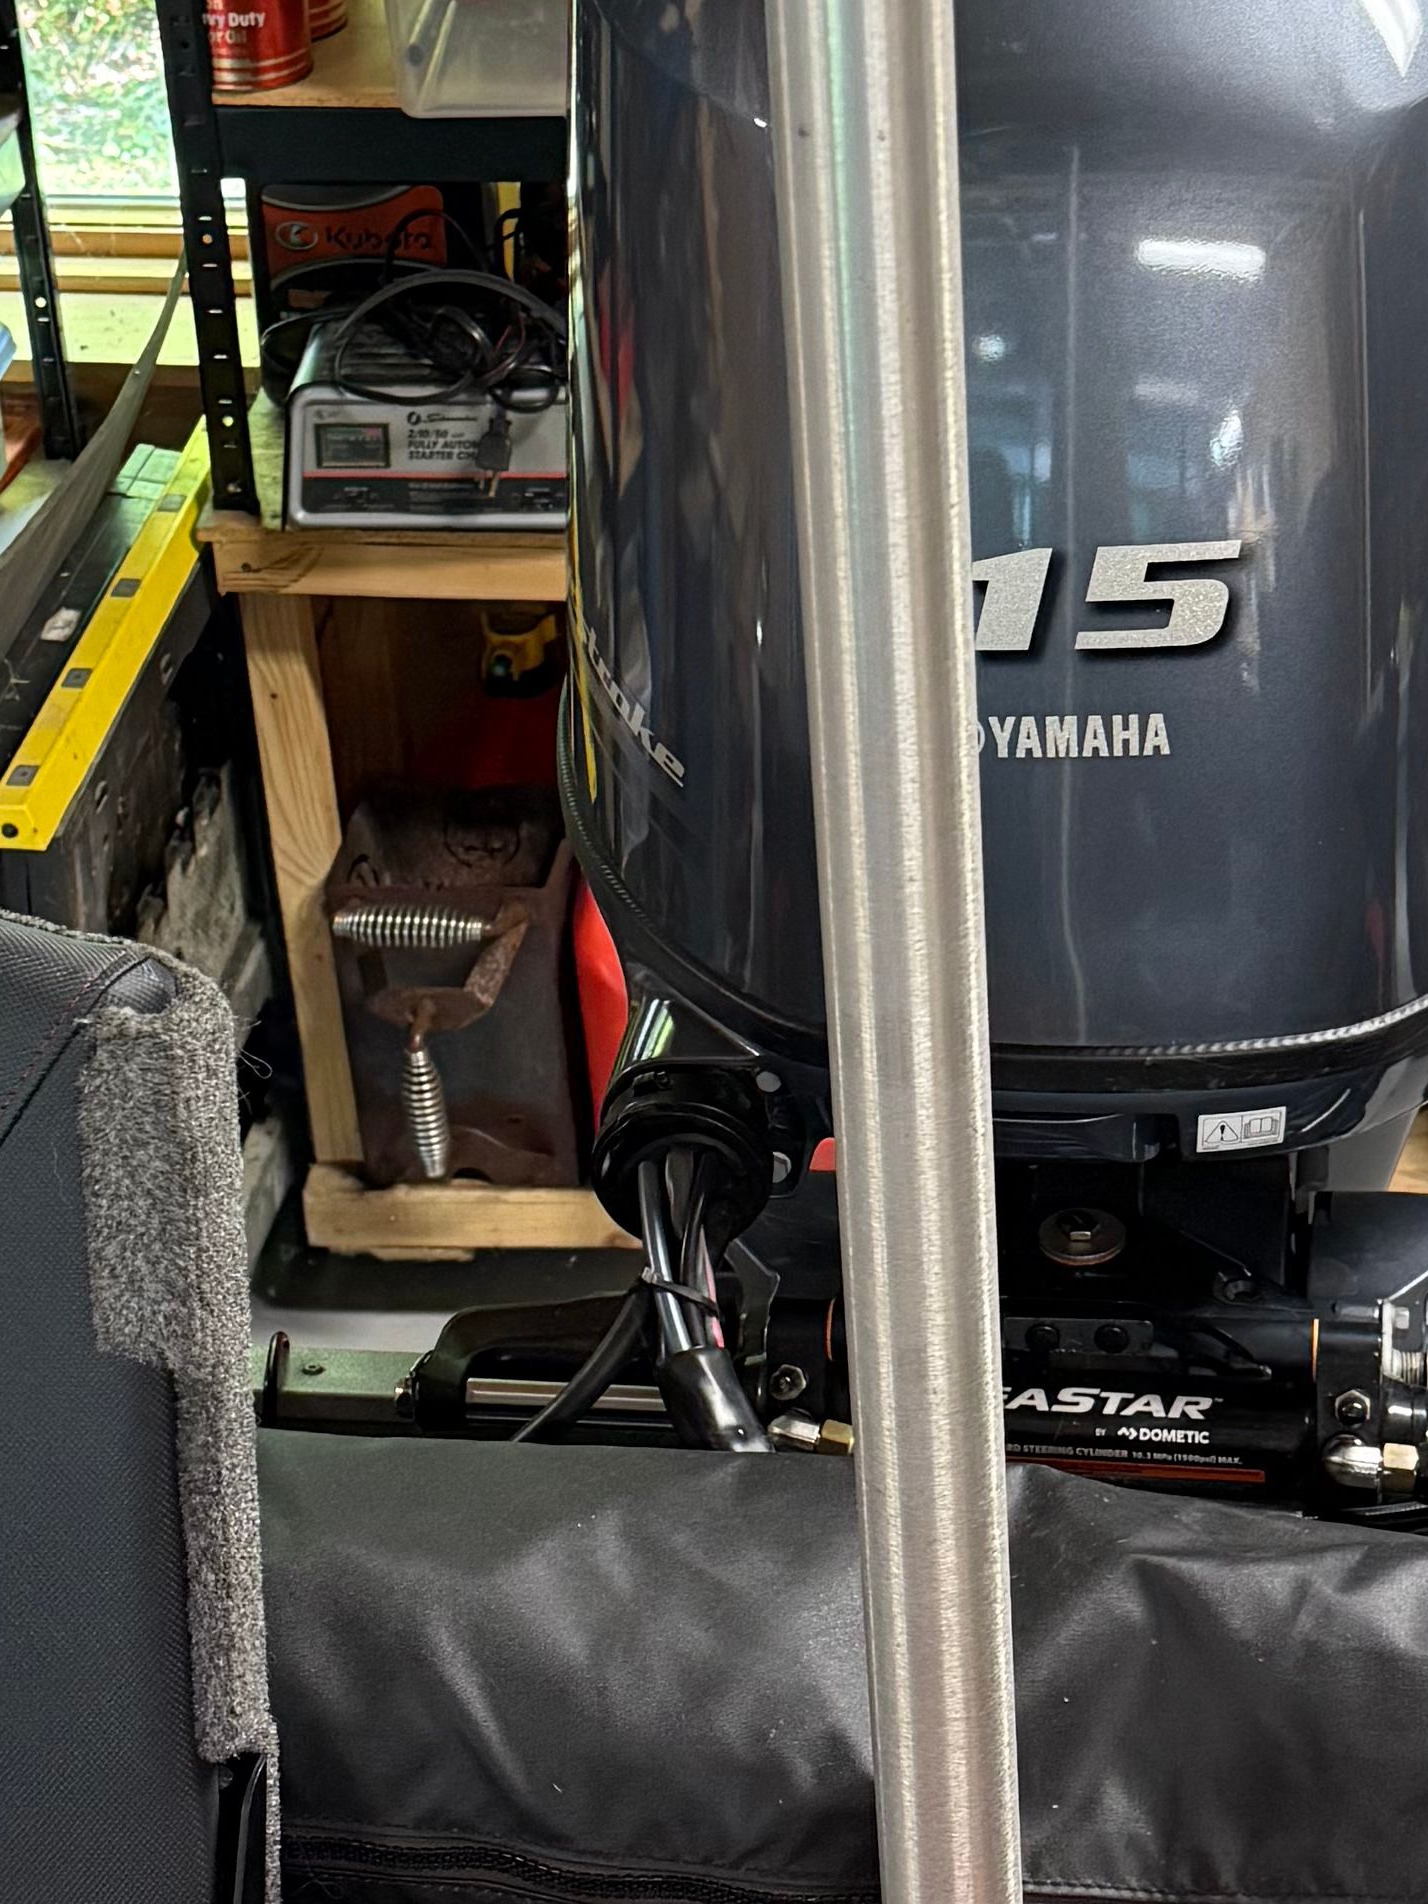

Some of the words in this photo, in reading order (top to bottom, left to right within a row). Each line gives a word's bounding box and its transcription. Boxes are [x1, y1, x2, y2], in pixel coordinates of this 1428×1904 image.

[988, 713, 1171, 759] YAMAHA
[1003, 1386, 1214, 1421] ASTAR
[1095, 1427, 1108, 1437] BY
[1139, 1427, 1211, 1445] DOMETIC
[1023, 1444, 1074, 1456] STEERING
[1075, 1446, 1129, 1459] CYLINDER
